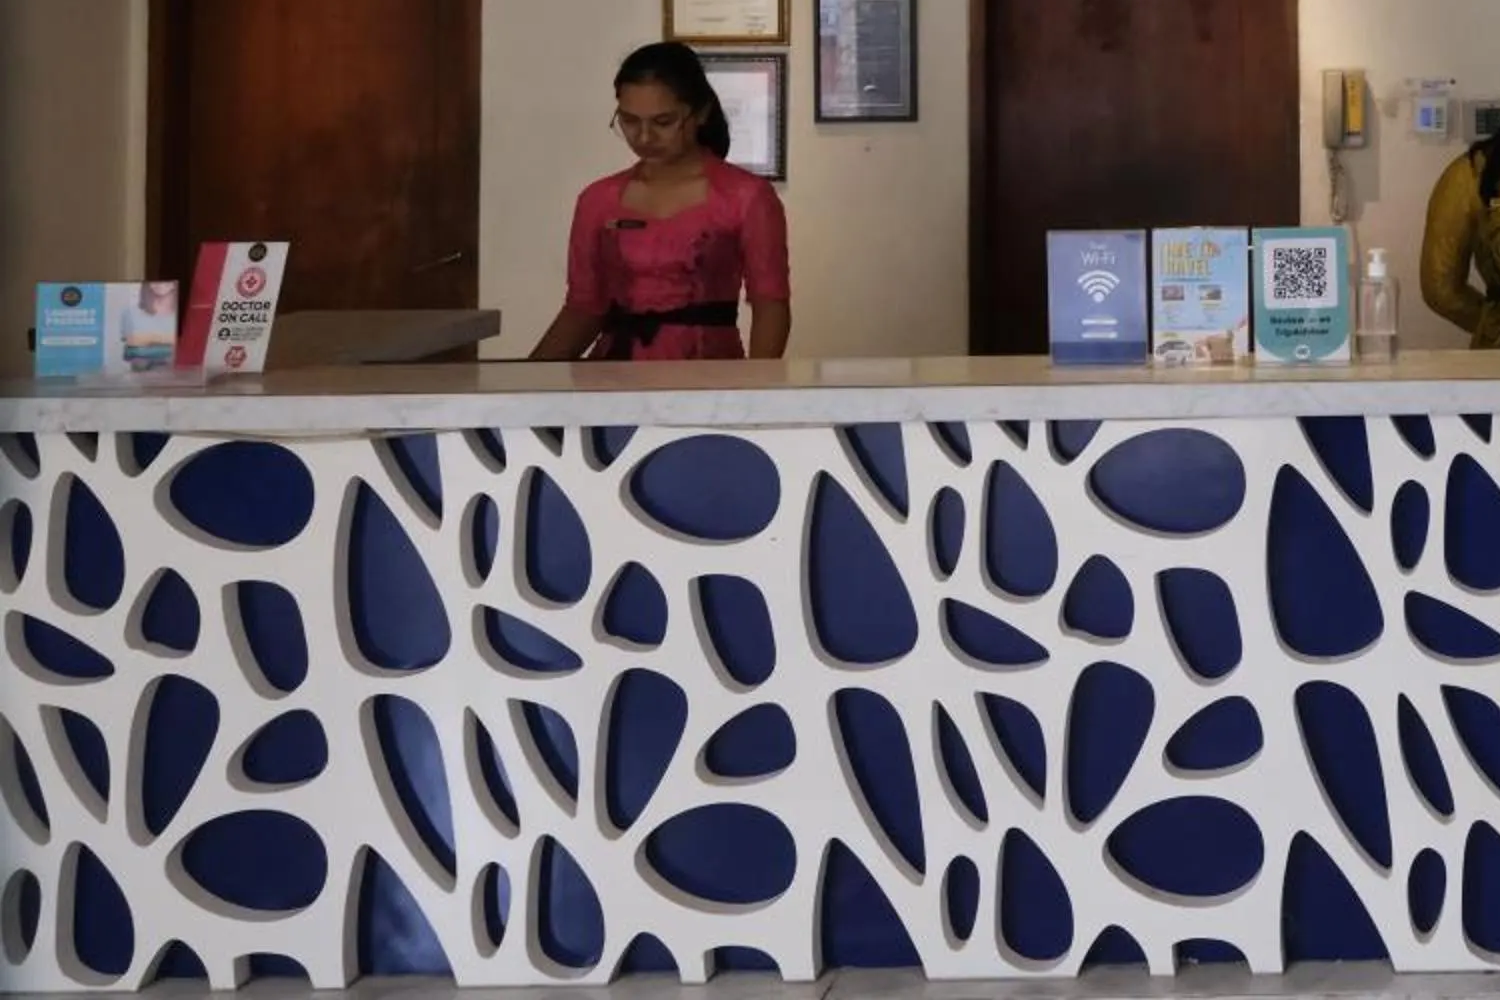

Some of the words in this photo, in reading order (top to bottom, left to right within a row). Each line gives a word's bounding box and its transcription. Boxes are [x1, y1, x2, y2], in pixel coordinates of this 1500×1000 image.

[221, 301, 271, 312] DOCTOR
[218, 313, 237, 323] ON
[240, 313, 268, 323] CALL
